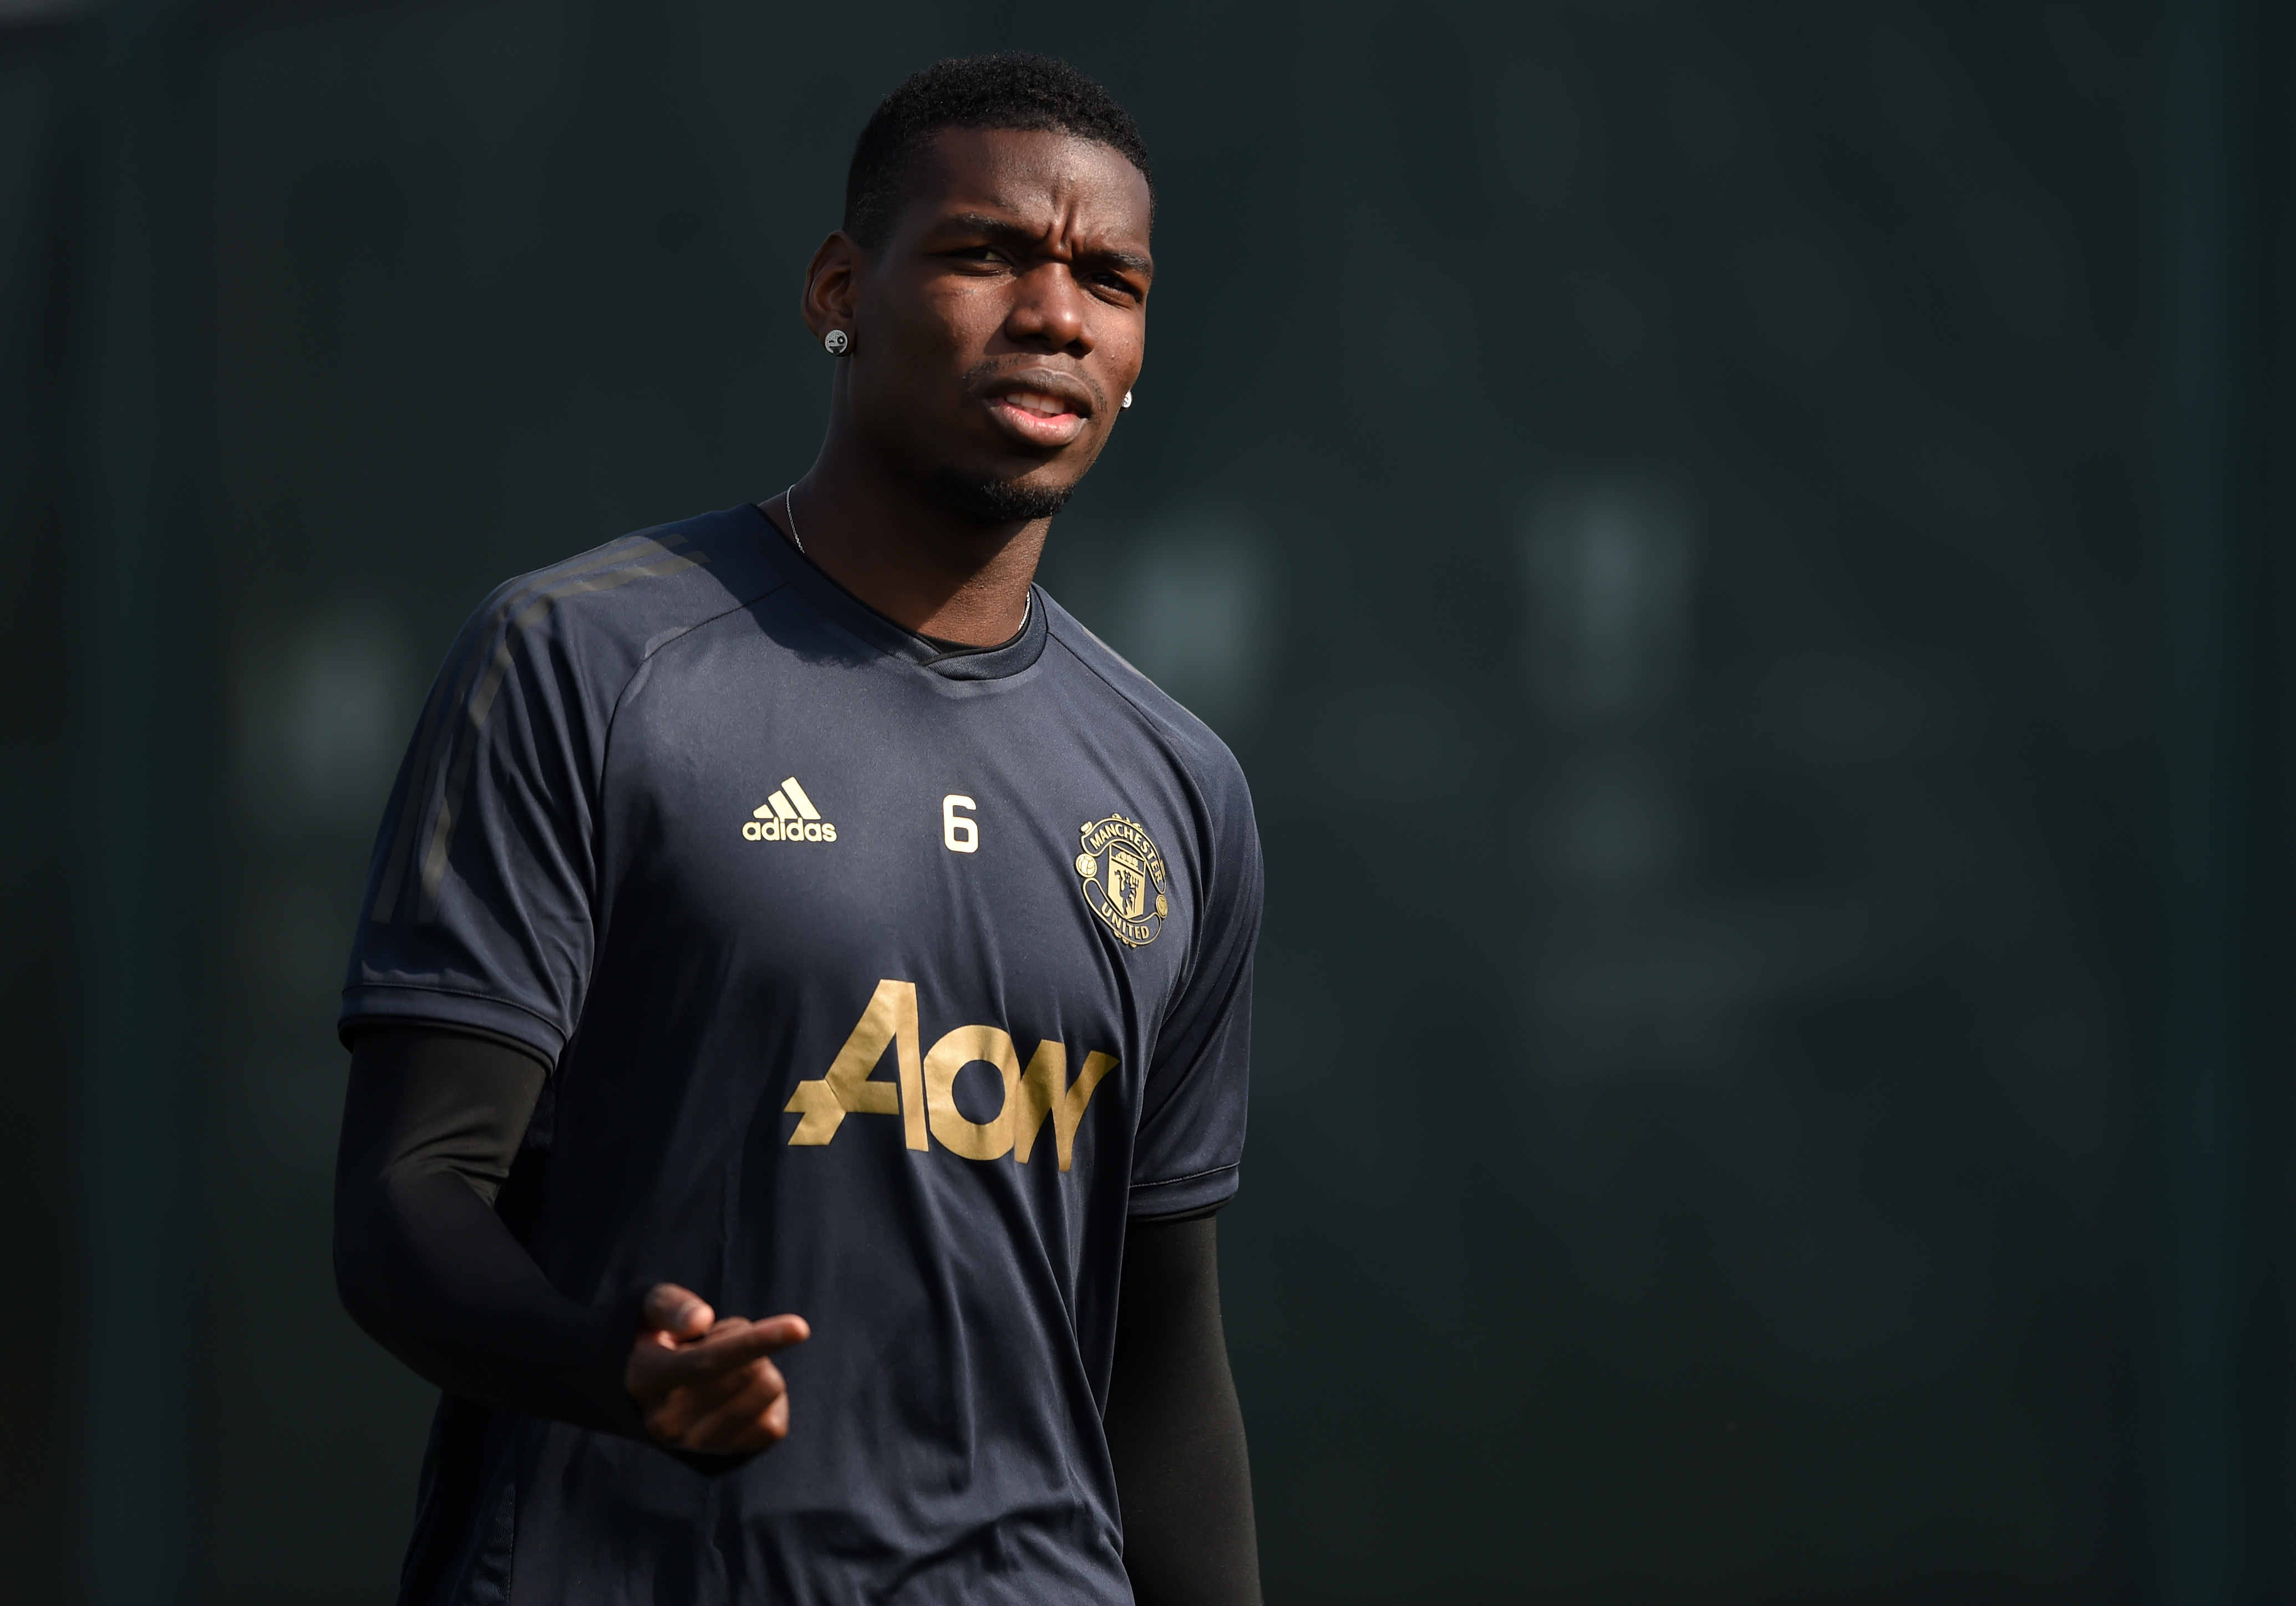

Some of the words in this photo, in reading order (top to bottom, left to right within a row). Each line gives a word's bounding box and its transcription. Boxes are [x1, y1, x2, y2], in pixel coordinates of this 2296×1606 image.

[742, 816, 837, 842] adidas
[943, 794, 979, 853] 6
[1089, 823, 1164, 884] MANCHESTER
[1101, 901, 1150, 939] UNITED
[784, 979, 1120, 1172] AON
